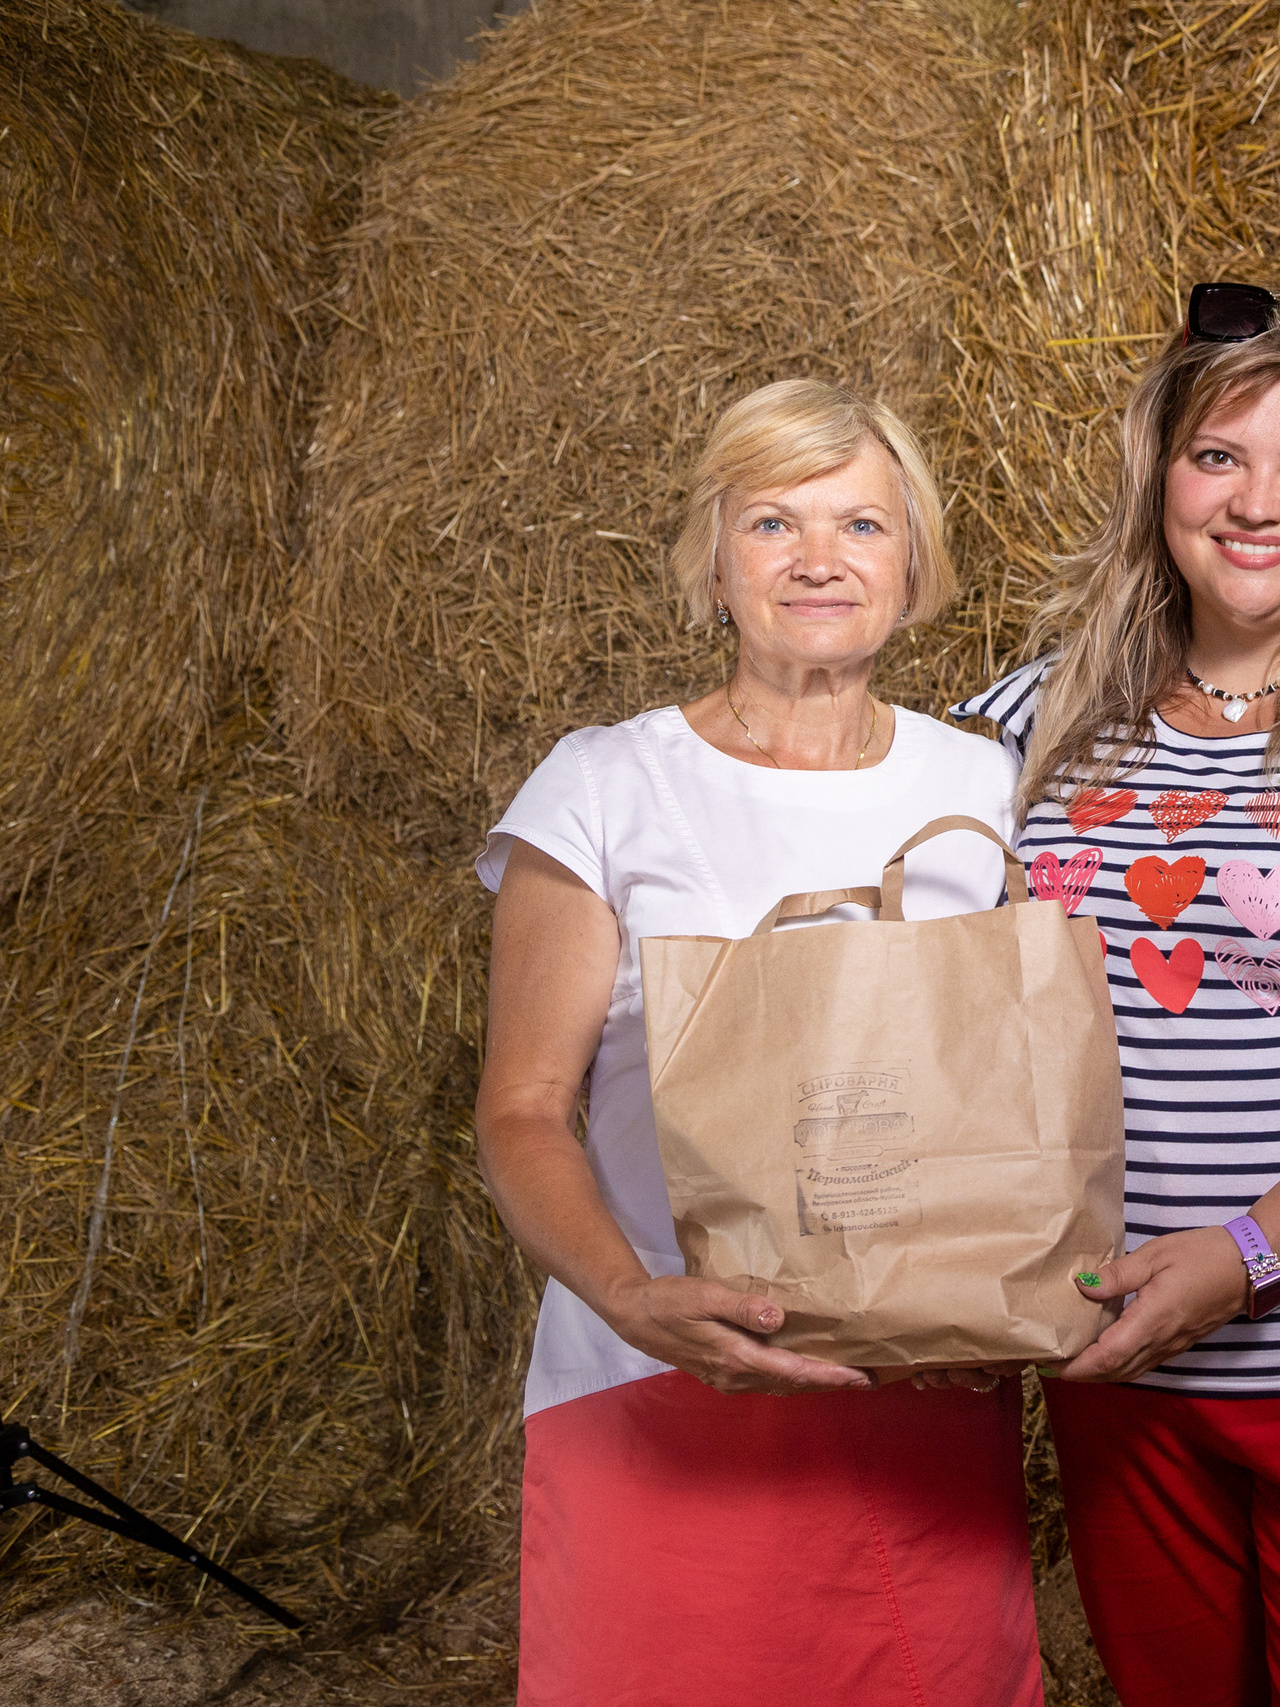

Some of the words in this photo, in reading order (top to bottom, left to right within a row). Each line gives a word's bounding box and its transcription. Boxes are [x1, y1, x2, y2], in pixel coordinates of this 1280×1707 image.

[801, 1075, 899, 1095] СЫРОВАРНЯ
[807, 1102, 834, 1112] Hand
[861, 1098, 887, 1110] Craft
[806, 1159, 912, 1186] Первомайский
[831, 1206, 899, 1220] 8-913-424-5125
